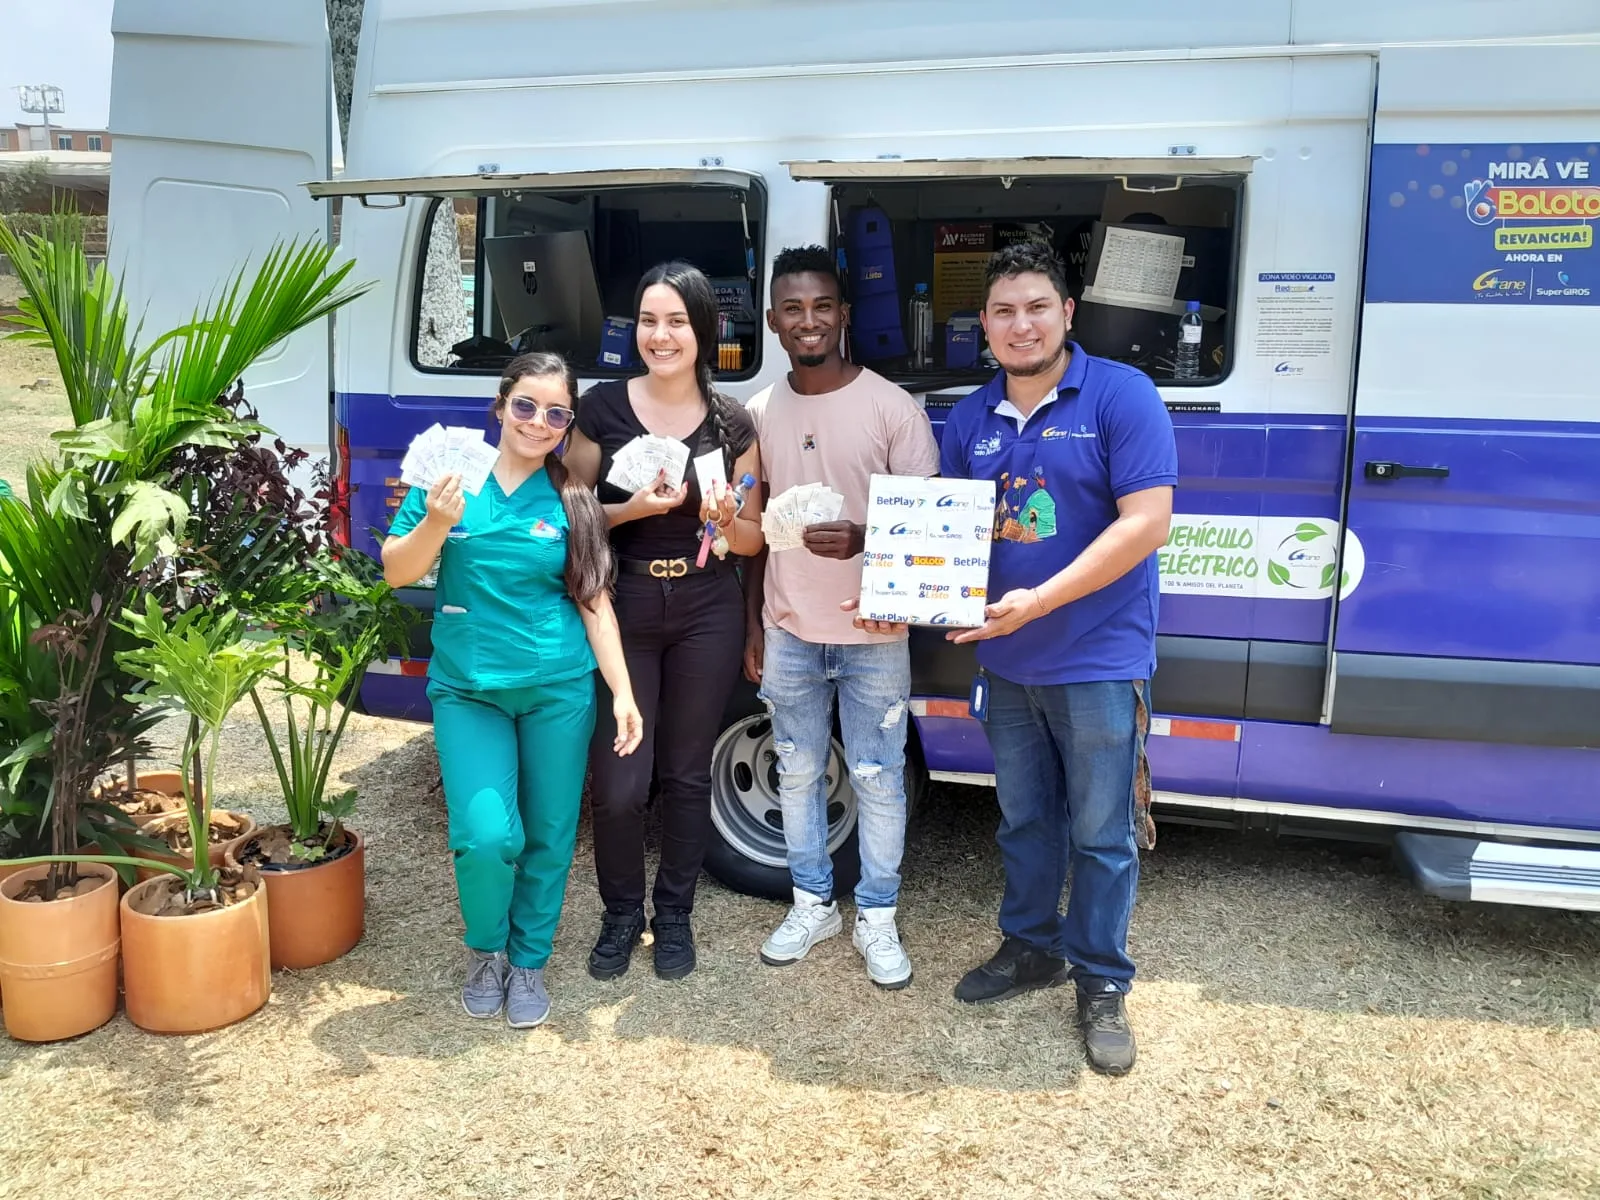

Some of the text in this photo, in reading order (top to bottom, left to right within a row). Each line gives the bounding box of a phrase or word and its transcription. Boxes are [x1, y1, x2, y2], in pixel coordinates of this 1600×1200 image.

[1488, 158, 1590, 180] MIRÁ VE
[1498, 190, 1600, 215] Baloto
[998, 230, 1032, 239] Western
[1499, 231, 1588, 246] REVANCHA!
[1504, 253, 1563, 264] AHORA EN
[877, 496, 915, 508] BetPlay
[864, 551, 894, 562] Raspa
[913, 556, 946, 565] Baloto
[1158, 548, 1259, 578] ELÉCTRICO
[919, 582, 950, 593] Raspa
